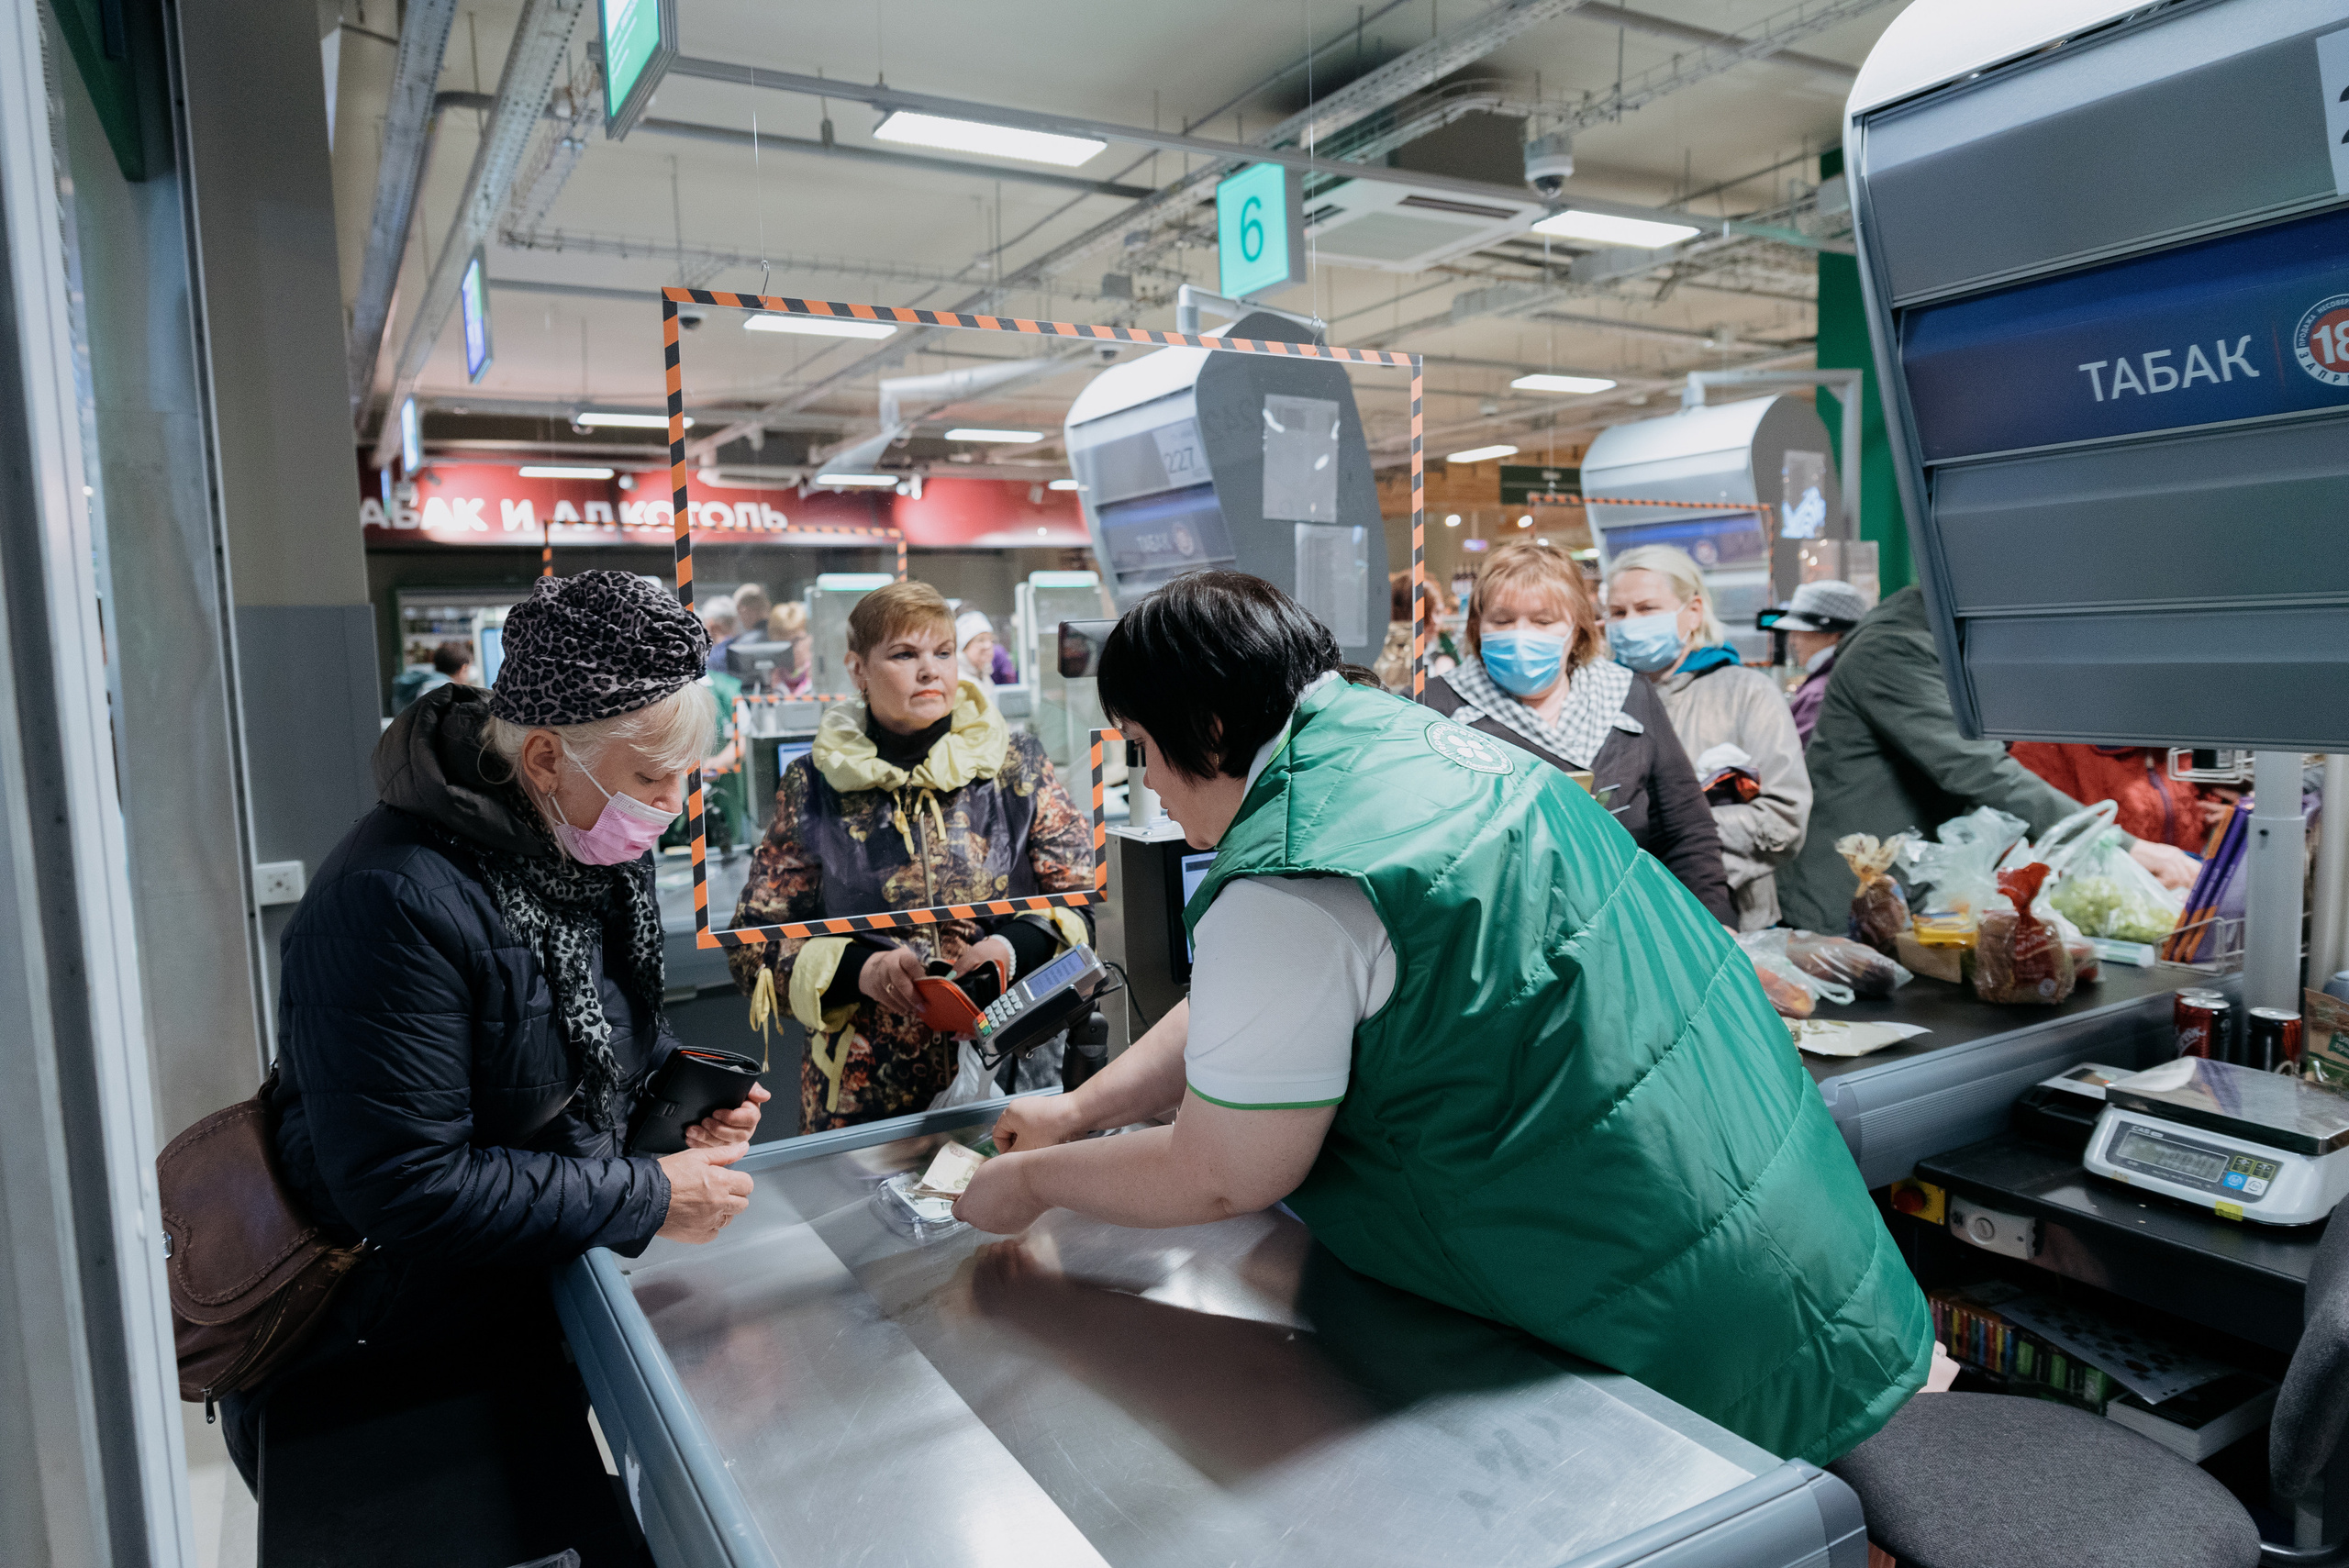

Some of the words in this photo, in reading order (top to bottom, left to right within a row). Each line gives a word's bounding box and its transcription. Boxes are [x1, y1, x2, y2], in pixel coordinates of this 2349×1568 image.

[1241, 195, 1264, 263] 6
[2298, 314, 2317, 347] ПРОДАЖА
[2078, 334, 2260, 402] ТАБАК
[2298, 351, 2349, 384] ЗАПР
[1163, 447, 1195, 474] 227
[500, 498, 536, 531] И
